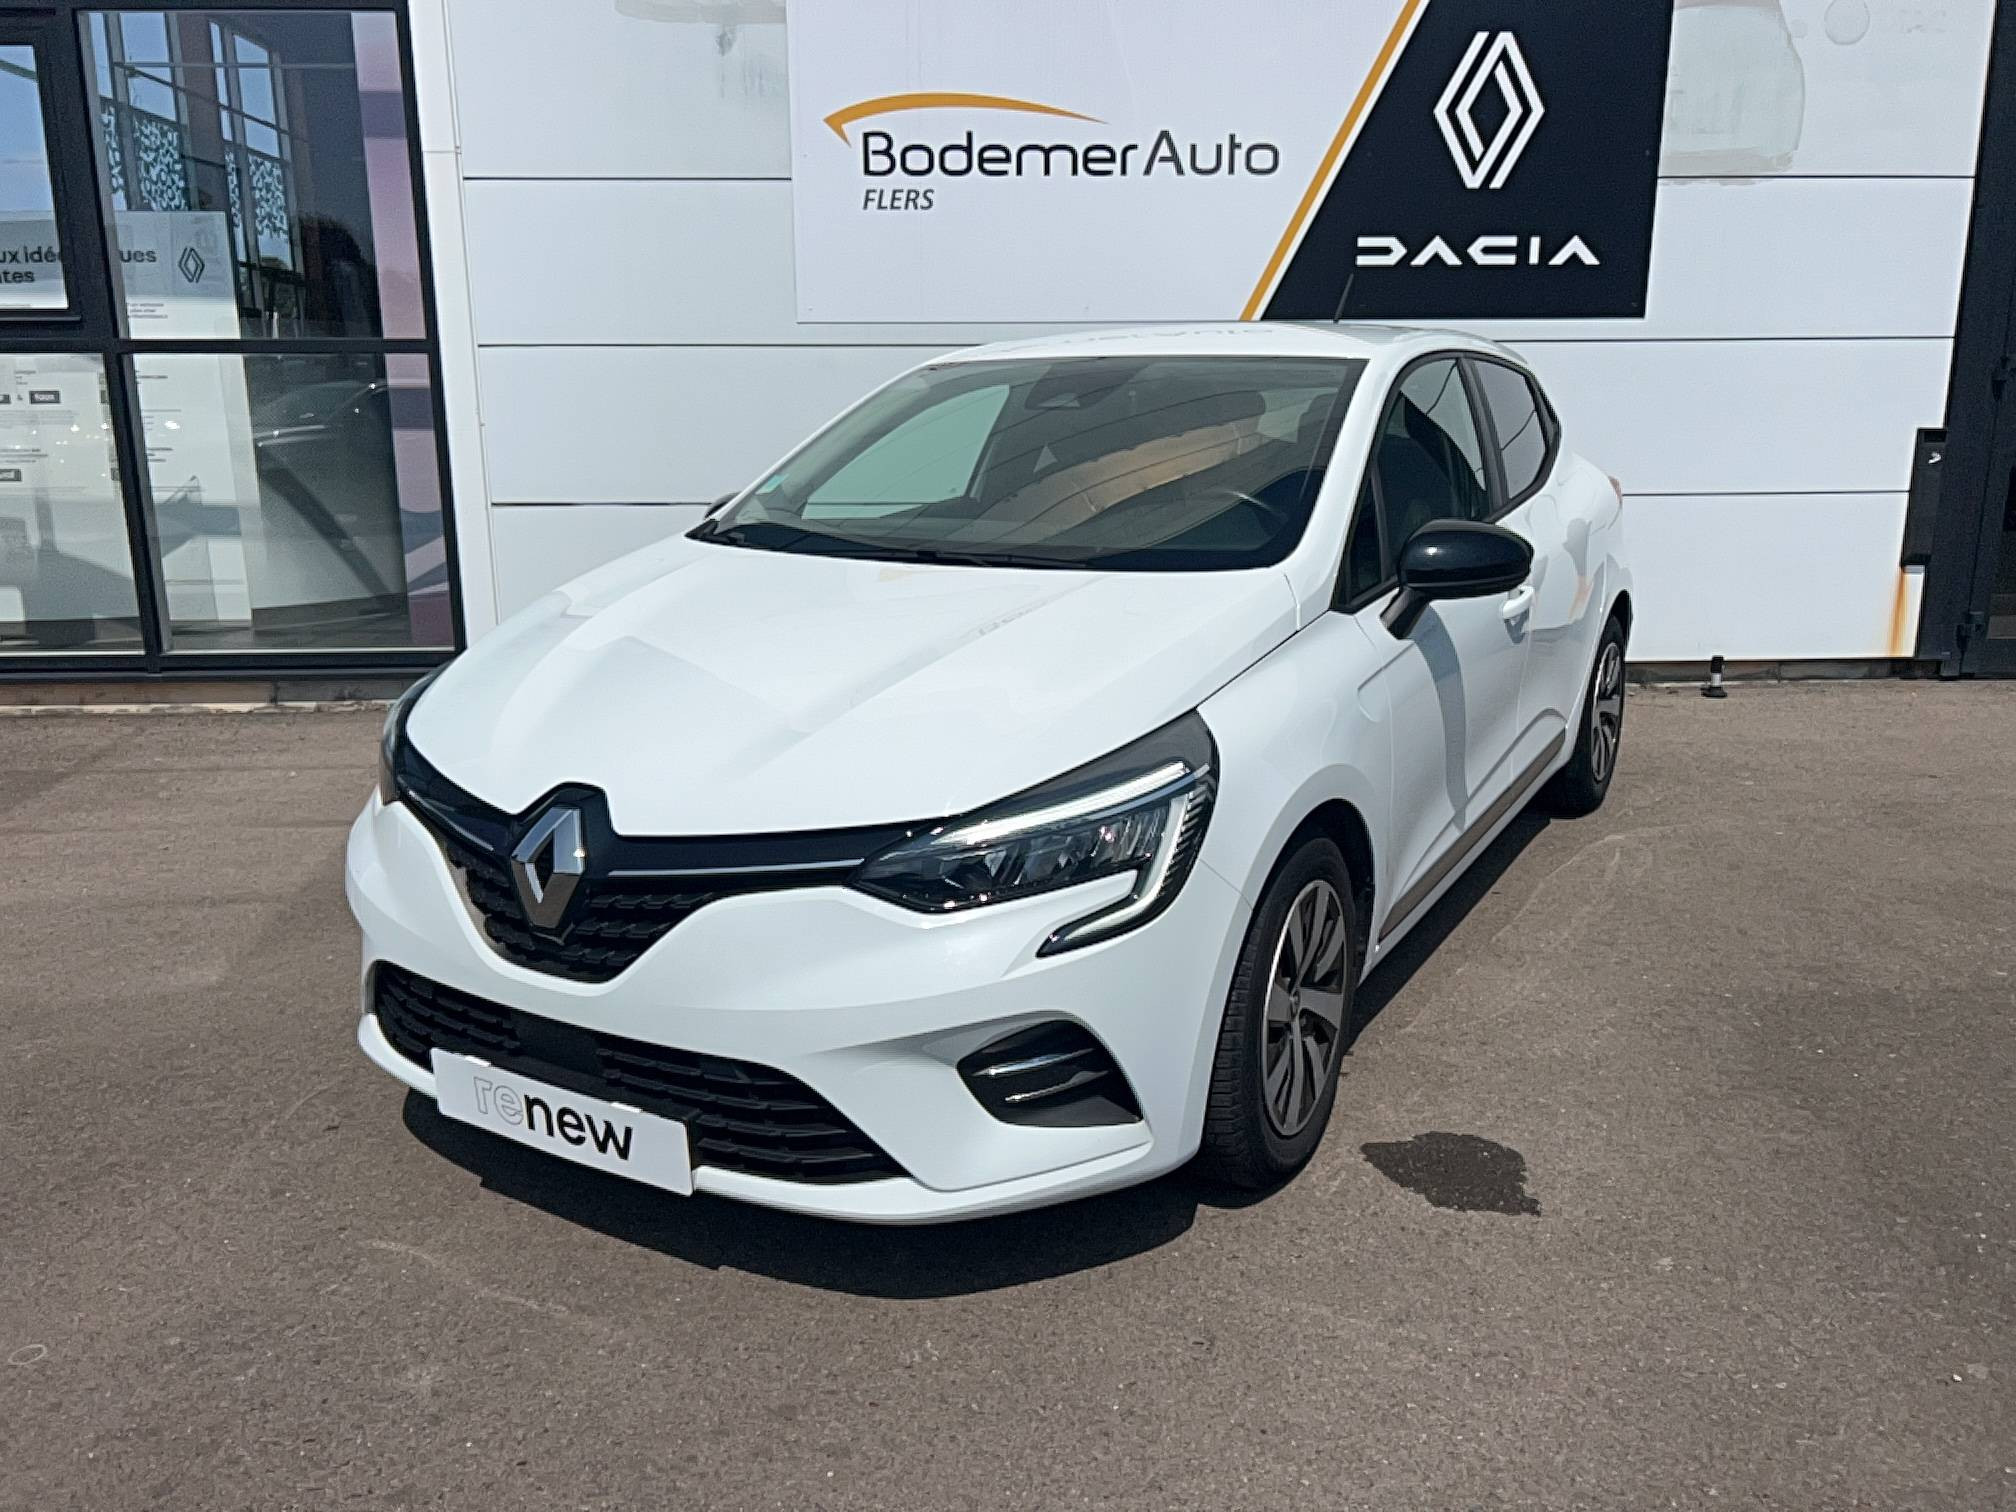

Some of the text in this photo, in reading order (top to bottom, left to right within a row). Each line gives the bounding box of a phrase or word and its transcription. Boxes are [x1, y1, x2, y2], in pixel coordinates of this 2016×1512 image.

[862, 188, 935, 211] FLERS
[1354, 234, 1601, 267] DACIA
[0, 270, 35, 284] tes
[473, 1076, 634, 1161] renew
